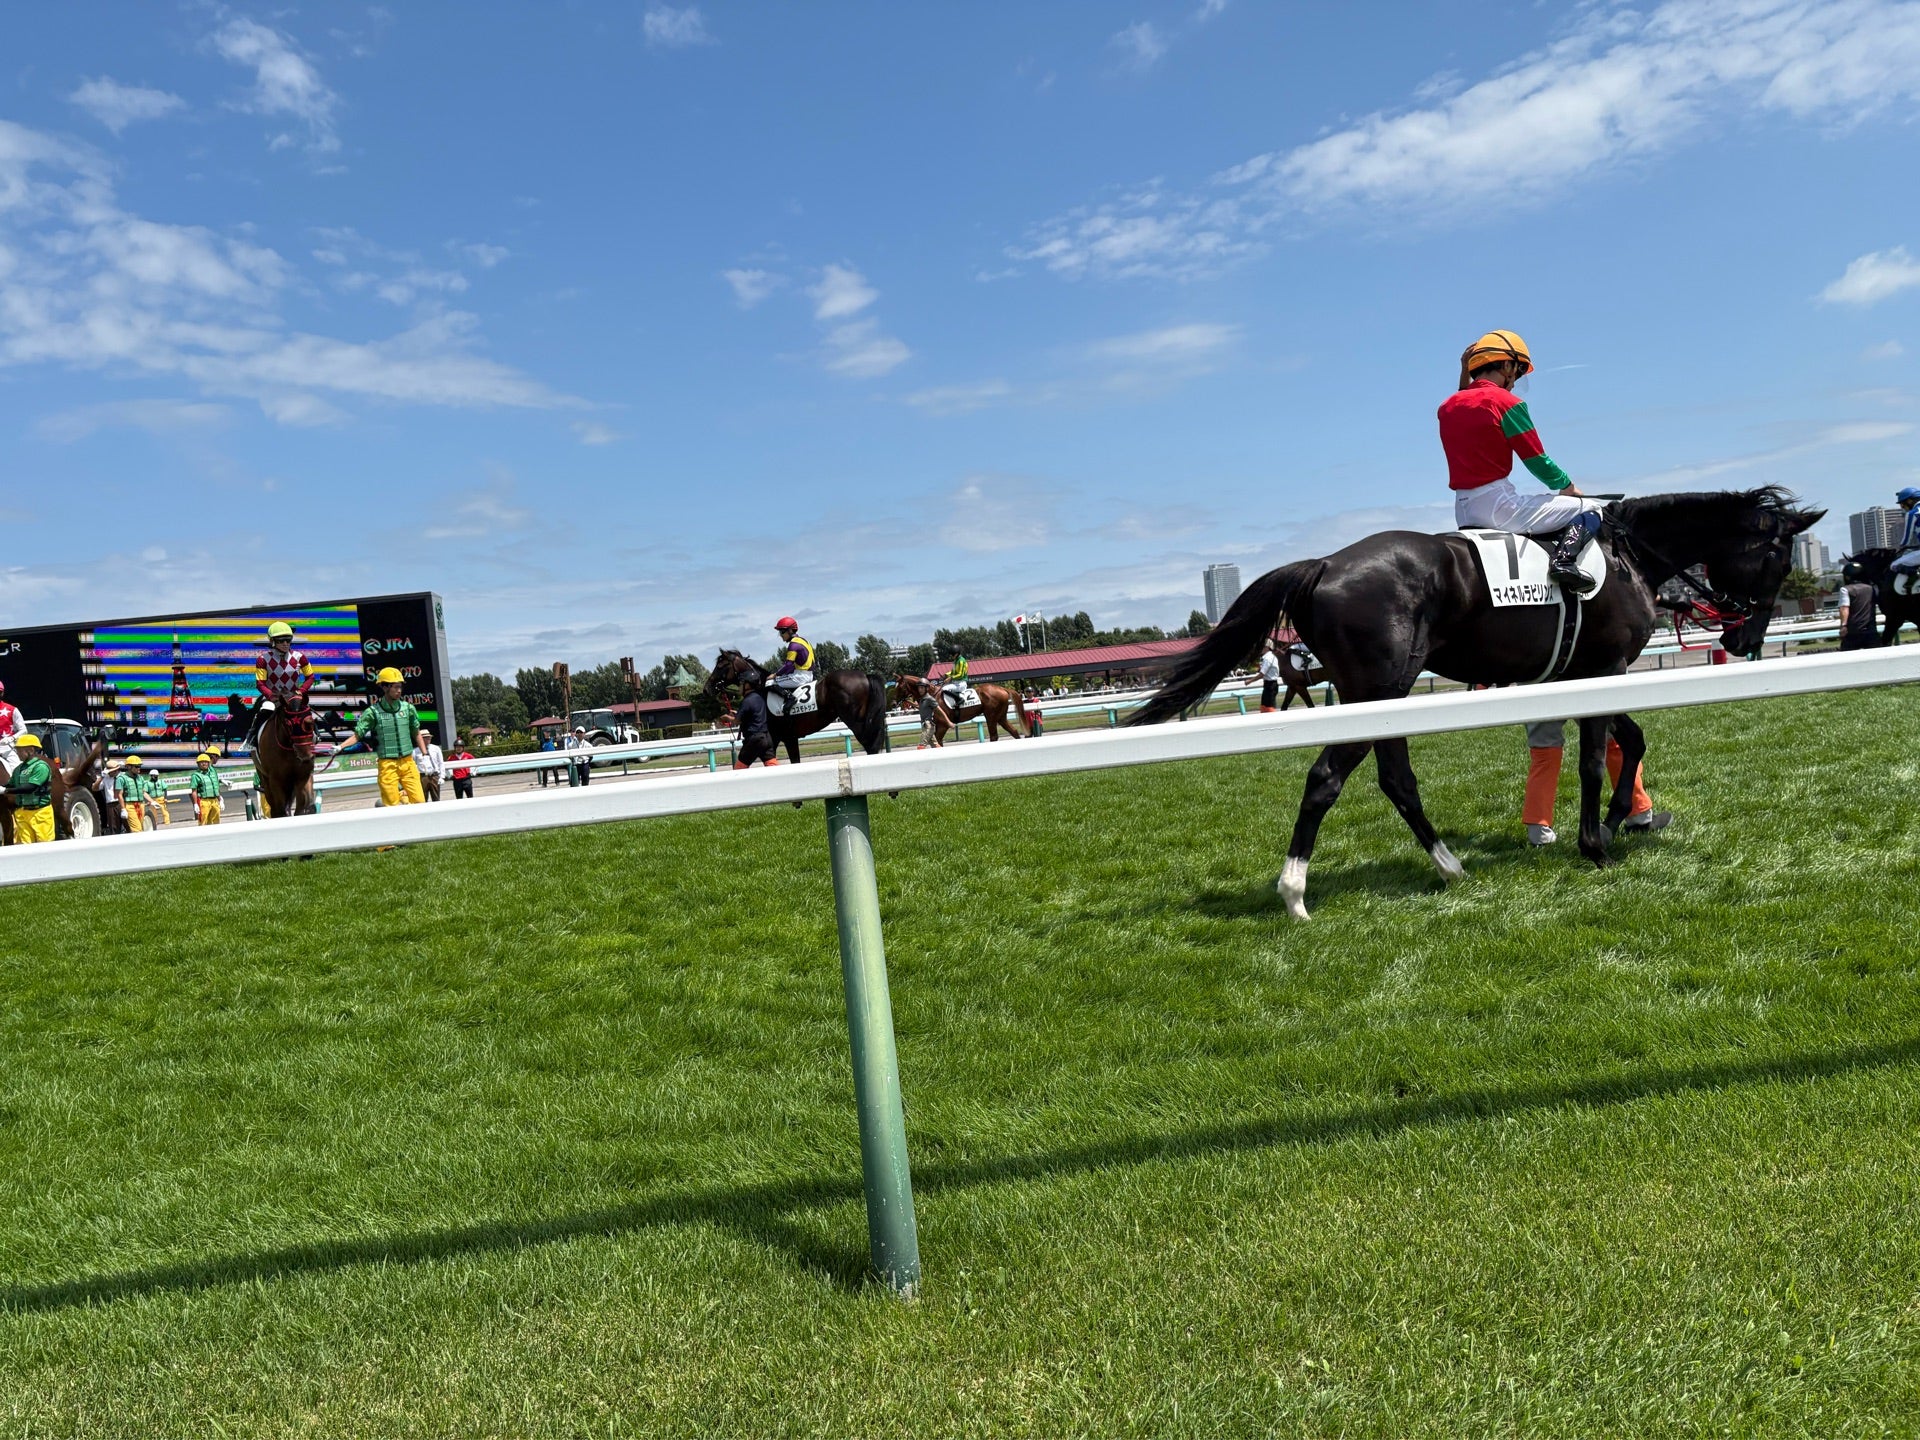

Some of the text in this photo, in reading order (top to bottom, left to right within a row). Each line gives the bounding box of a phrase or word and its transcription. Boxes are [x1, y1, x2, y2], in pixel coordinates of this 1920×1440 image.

[1479, 532, 1519, 580] 7
[1493, 584, 1554, 604] マイネルラビリンス
[383, 637, 413, 652] JRA
[366, 665, 422, 681] Soro
[799, 685, 811, 703] 3
[964, 690, 976, 701] 2
